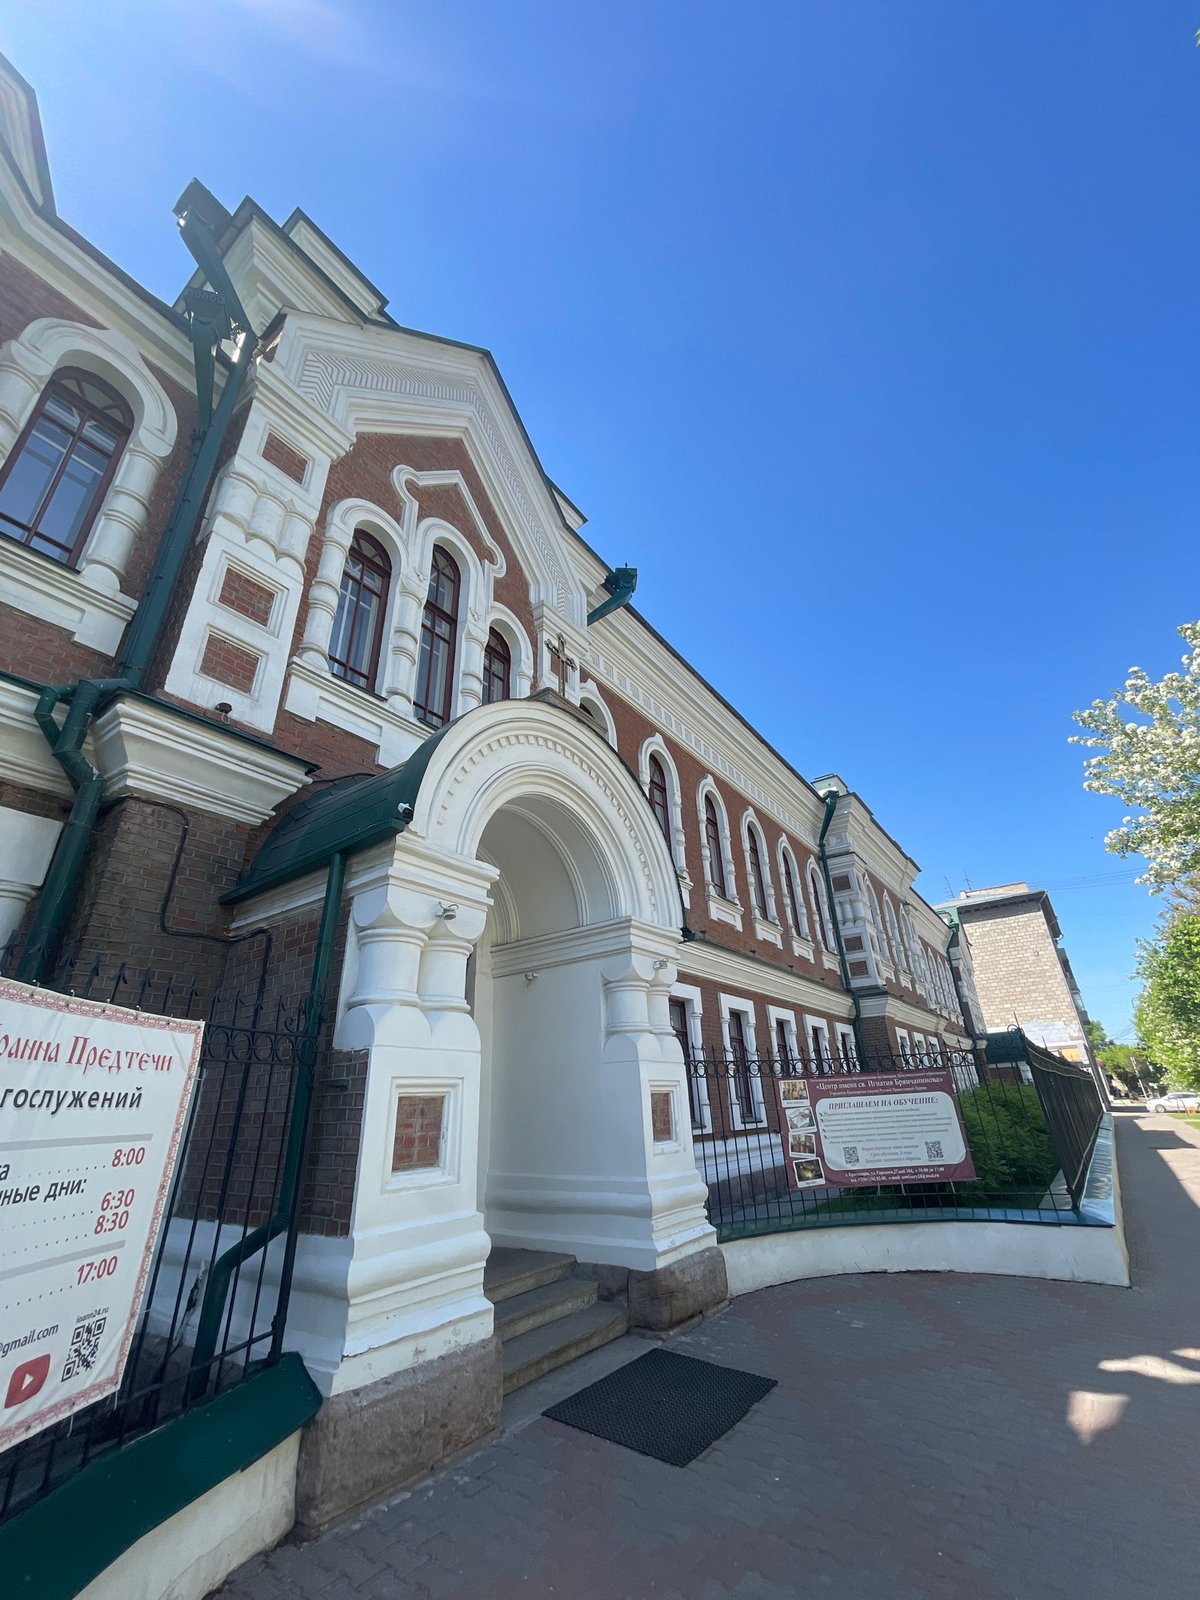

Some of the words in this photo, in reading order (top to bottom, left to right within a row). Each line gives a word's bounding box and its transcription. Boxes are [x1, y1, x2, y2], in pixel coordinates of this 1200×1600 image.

[828, 1100, 879, 1110] ПРИГЛАШАЕМ
[112, 1147, 146, 1168] 8:00
[43, 1178, 88, 1203] дни:
[101, 1188, 135, 1212] 6:30
[94, 1210, 130, 1235] 8:30
[77, 1255, 119, 1286] 17:00
[76, 1306, 110, 1323] ioann24.ru
